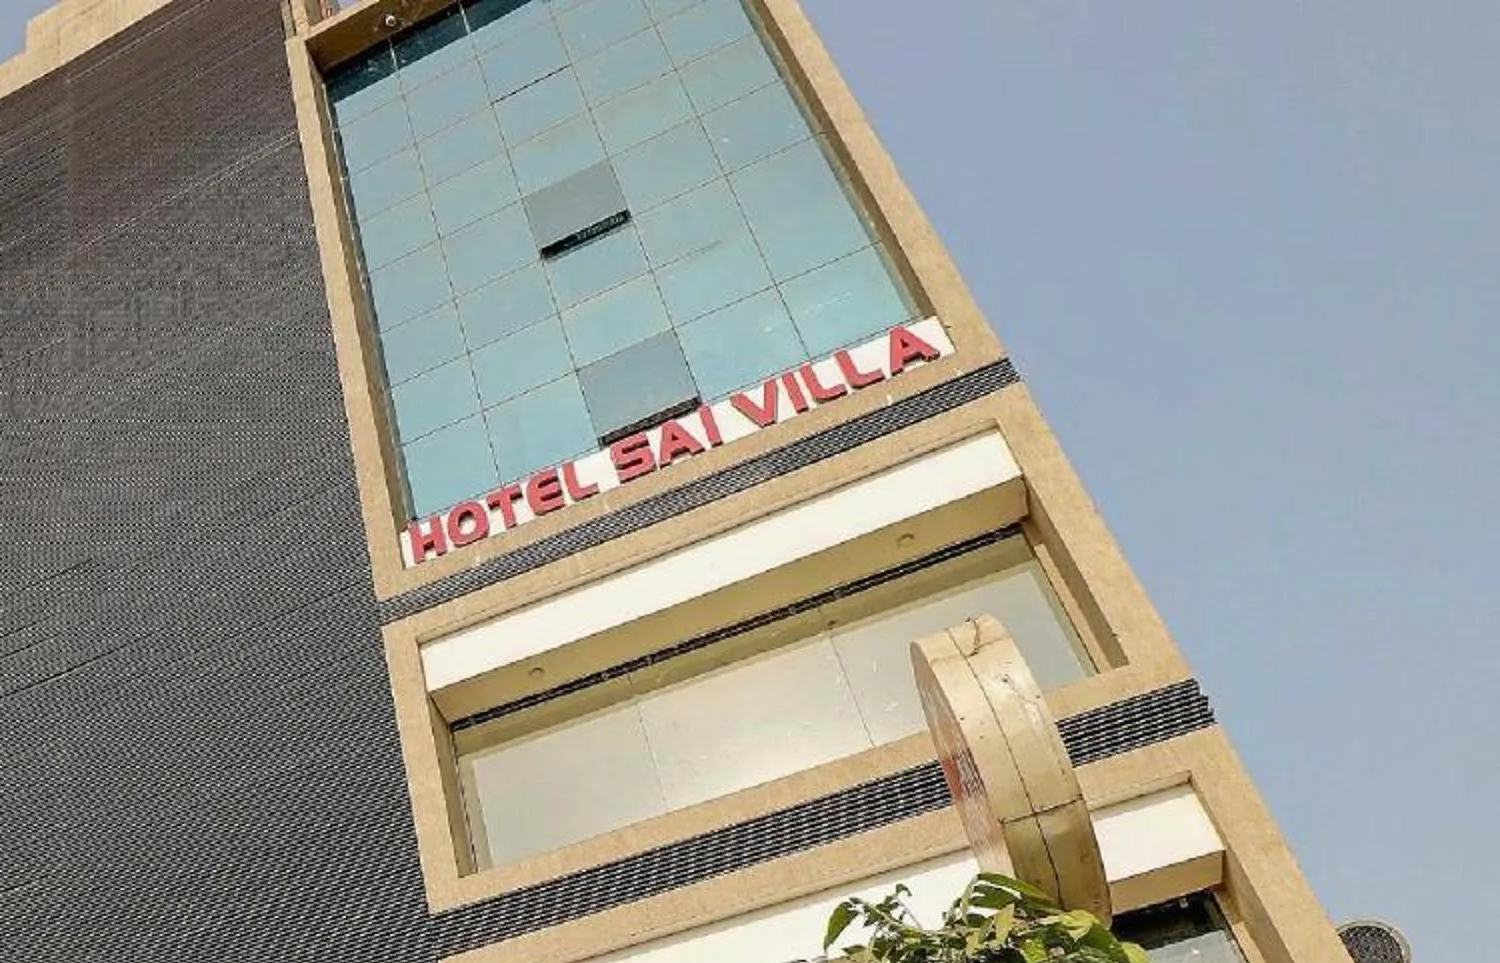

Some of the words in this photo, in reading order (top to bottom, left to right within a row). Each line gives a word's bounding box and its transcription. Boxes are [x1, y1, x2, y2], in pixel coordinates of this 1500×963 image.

[407, 460, 599, 563] HOTEL
[610, 402, 723, 484] SAI
[730, 325, 941, 428] VILLA
